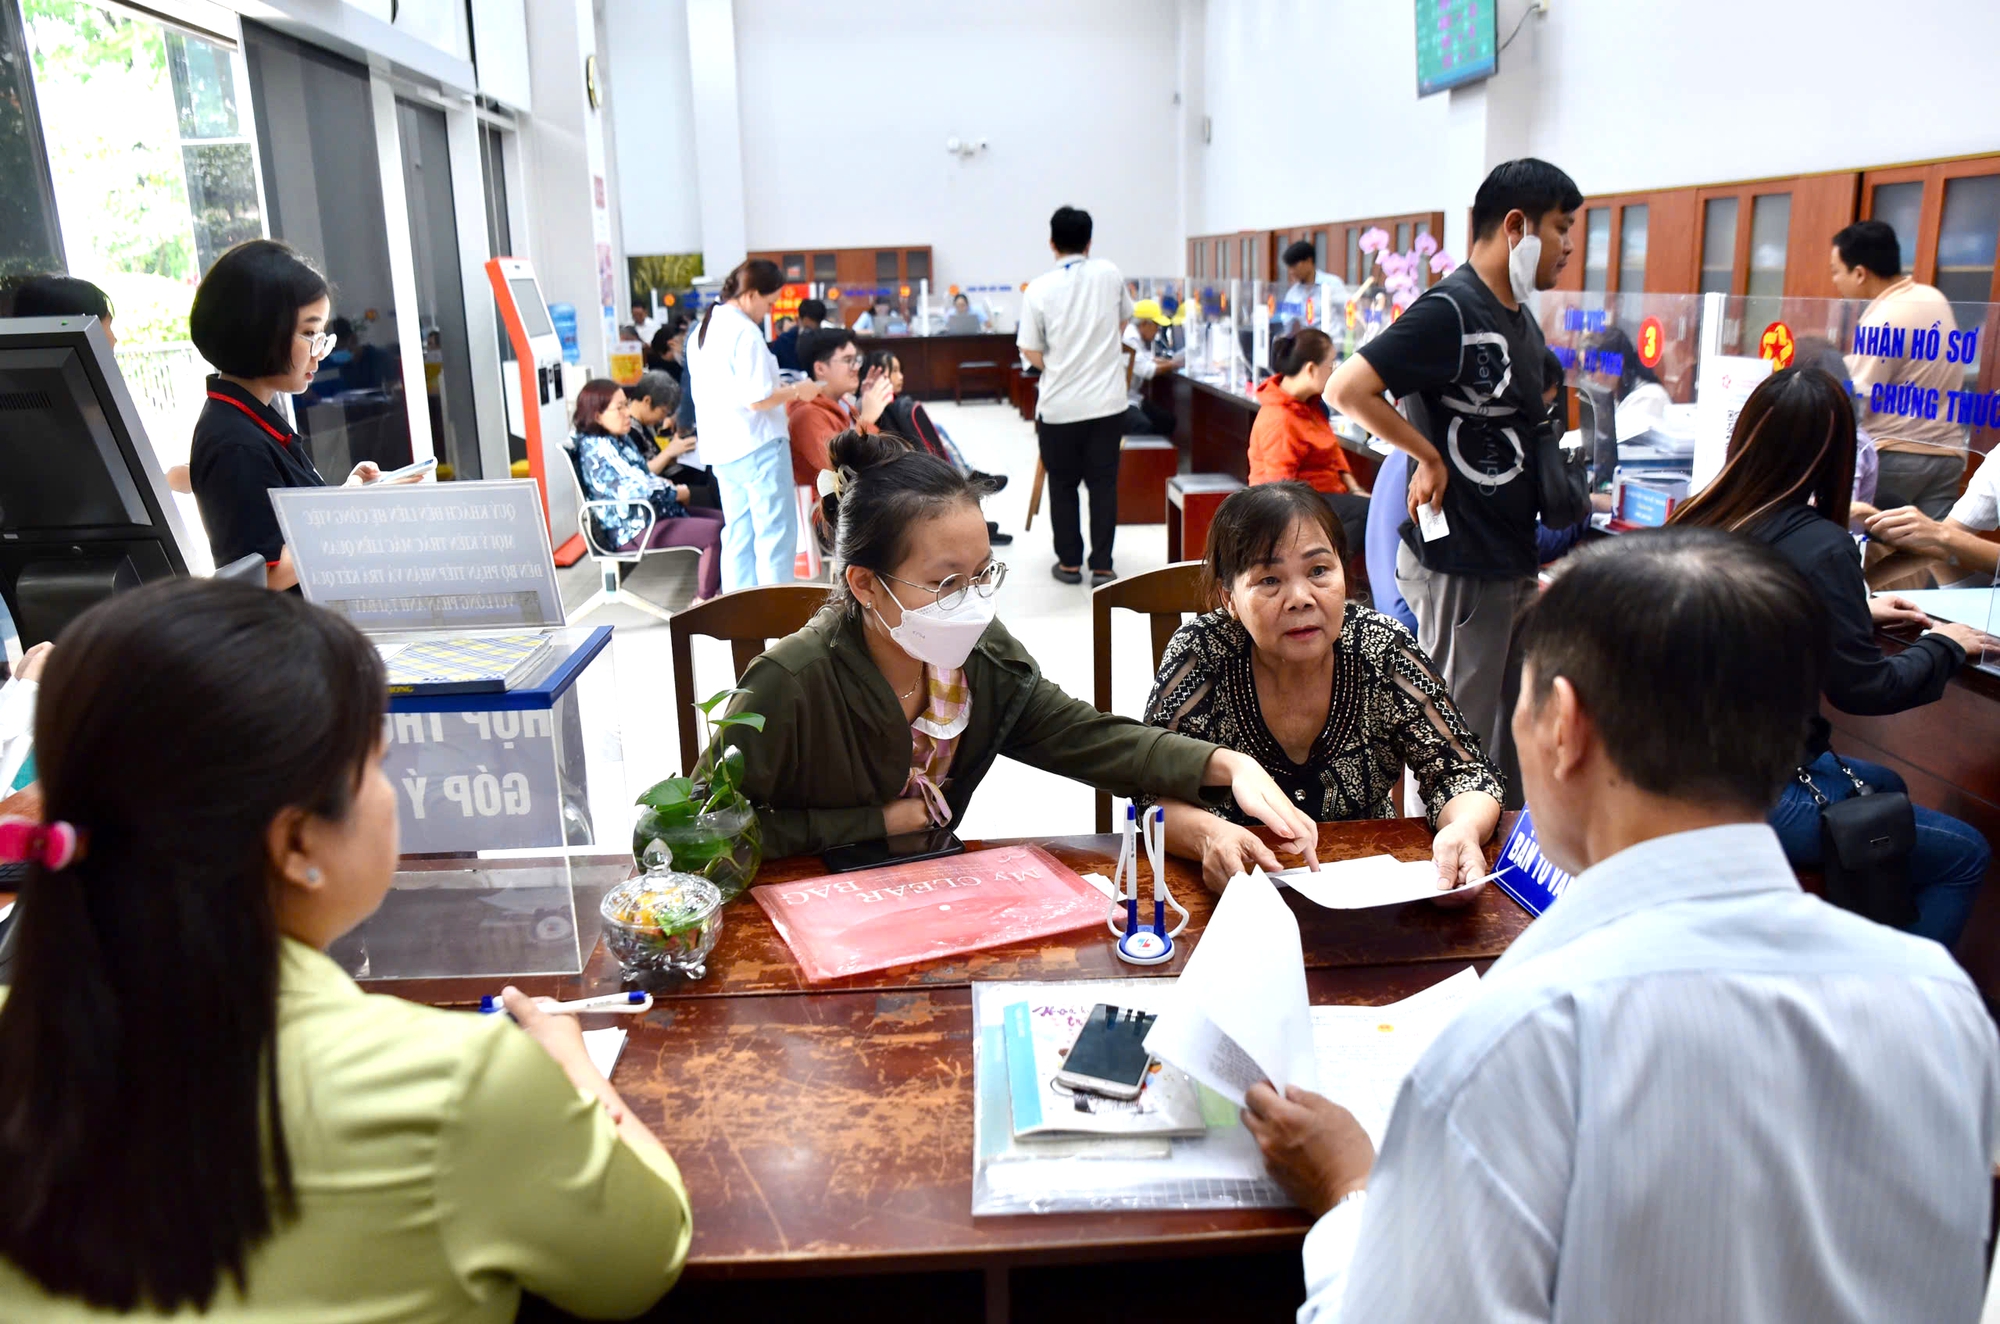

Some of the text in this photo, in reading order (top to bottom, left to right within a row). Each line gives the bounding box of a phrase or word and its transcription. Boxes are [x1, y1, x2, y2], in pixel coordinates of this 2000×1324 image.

[1644, 325, 1657, 359] 3
[1853, 320, 1979, 364] NHẬN HỒ SƠ
[1870, 380, 1940, 420] CHỨNG
[1946, 389, 2000, 434] THỰC
[780, 880, 863, 906] BAG
[856, 876, 982, 904] CLEAR
